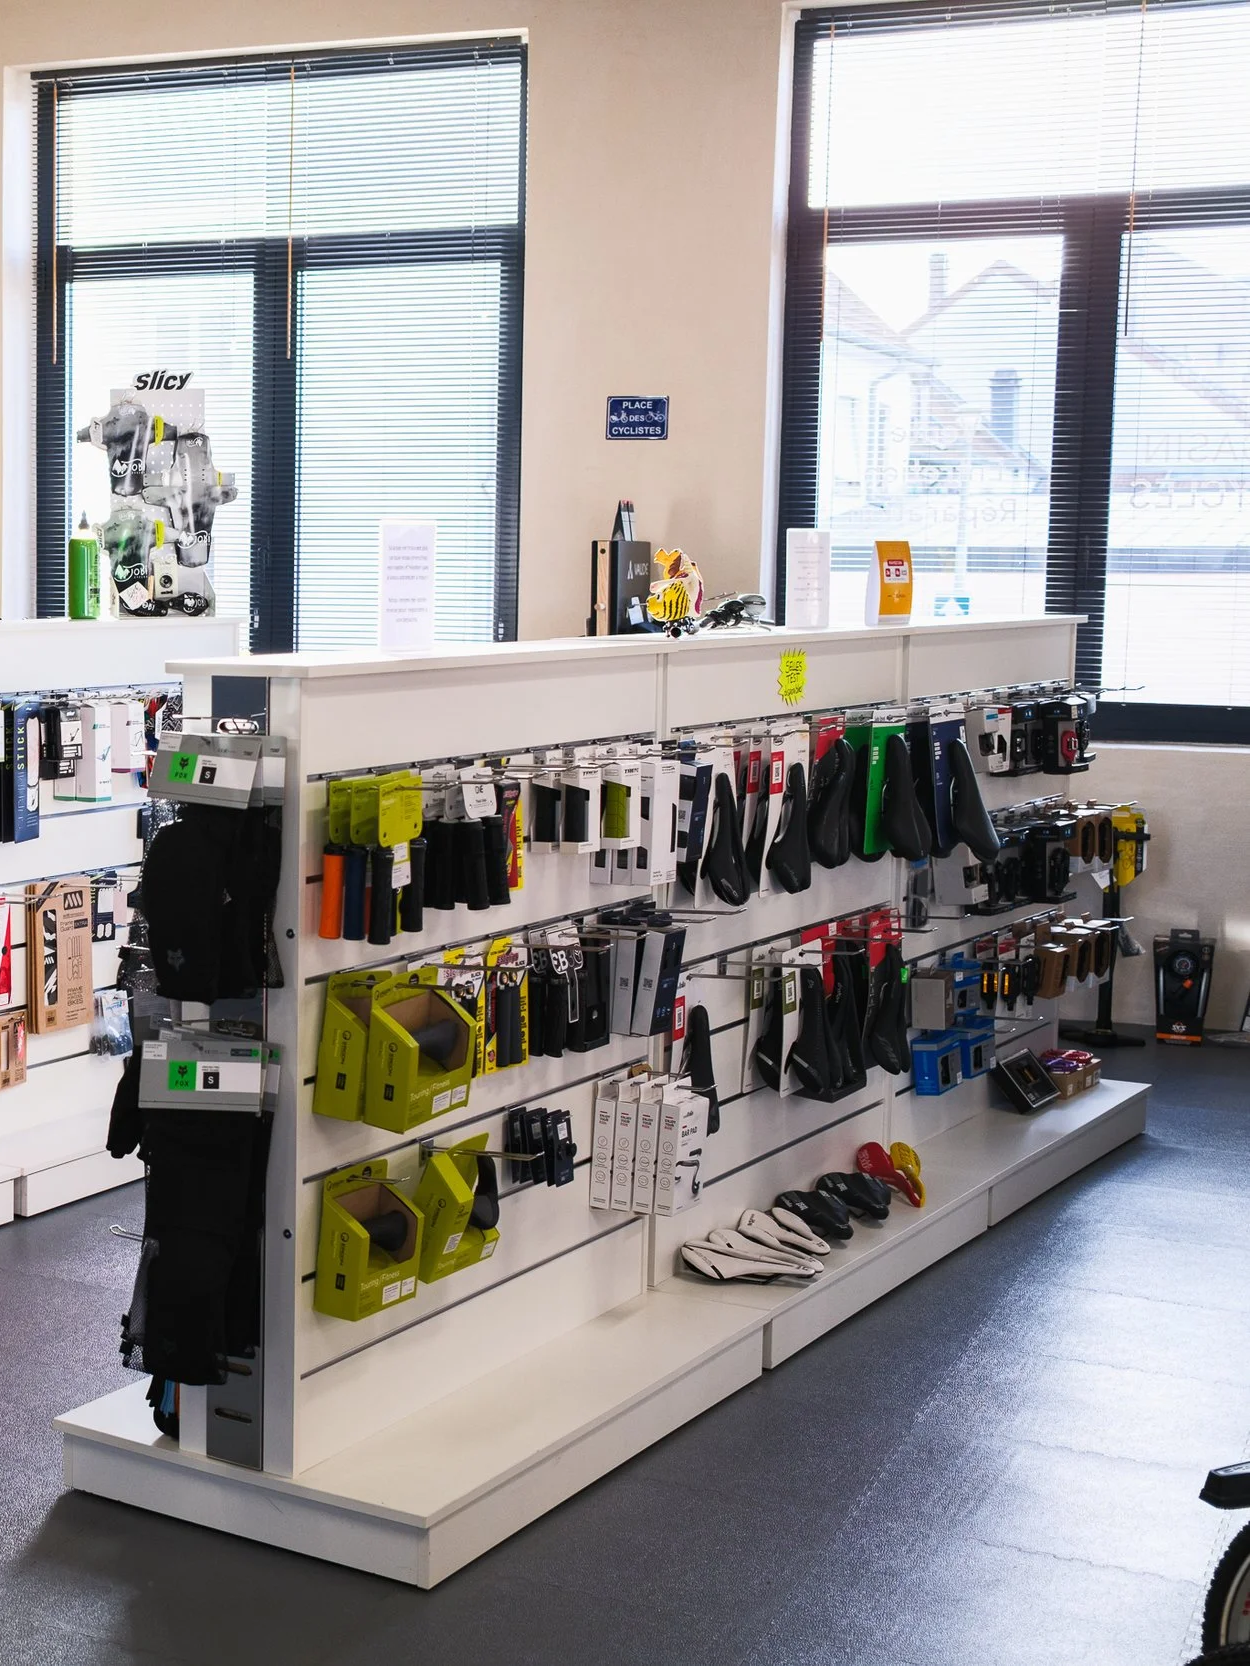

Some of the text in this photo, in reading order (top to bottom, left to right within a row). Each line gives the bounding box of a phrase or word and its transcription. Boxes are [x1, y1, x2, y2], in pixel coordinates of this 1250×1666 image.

[622, 401, 653, 409] PLACE
[612, 427, 661, 435] CYCLISTES
[16, 726, 25, 770] STICK
[175, 771, 188, 779] FOX
[204, 771, 211, 779] S
[207, 1076, 214, 1084] S
